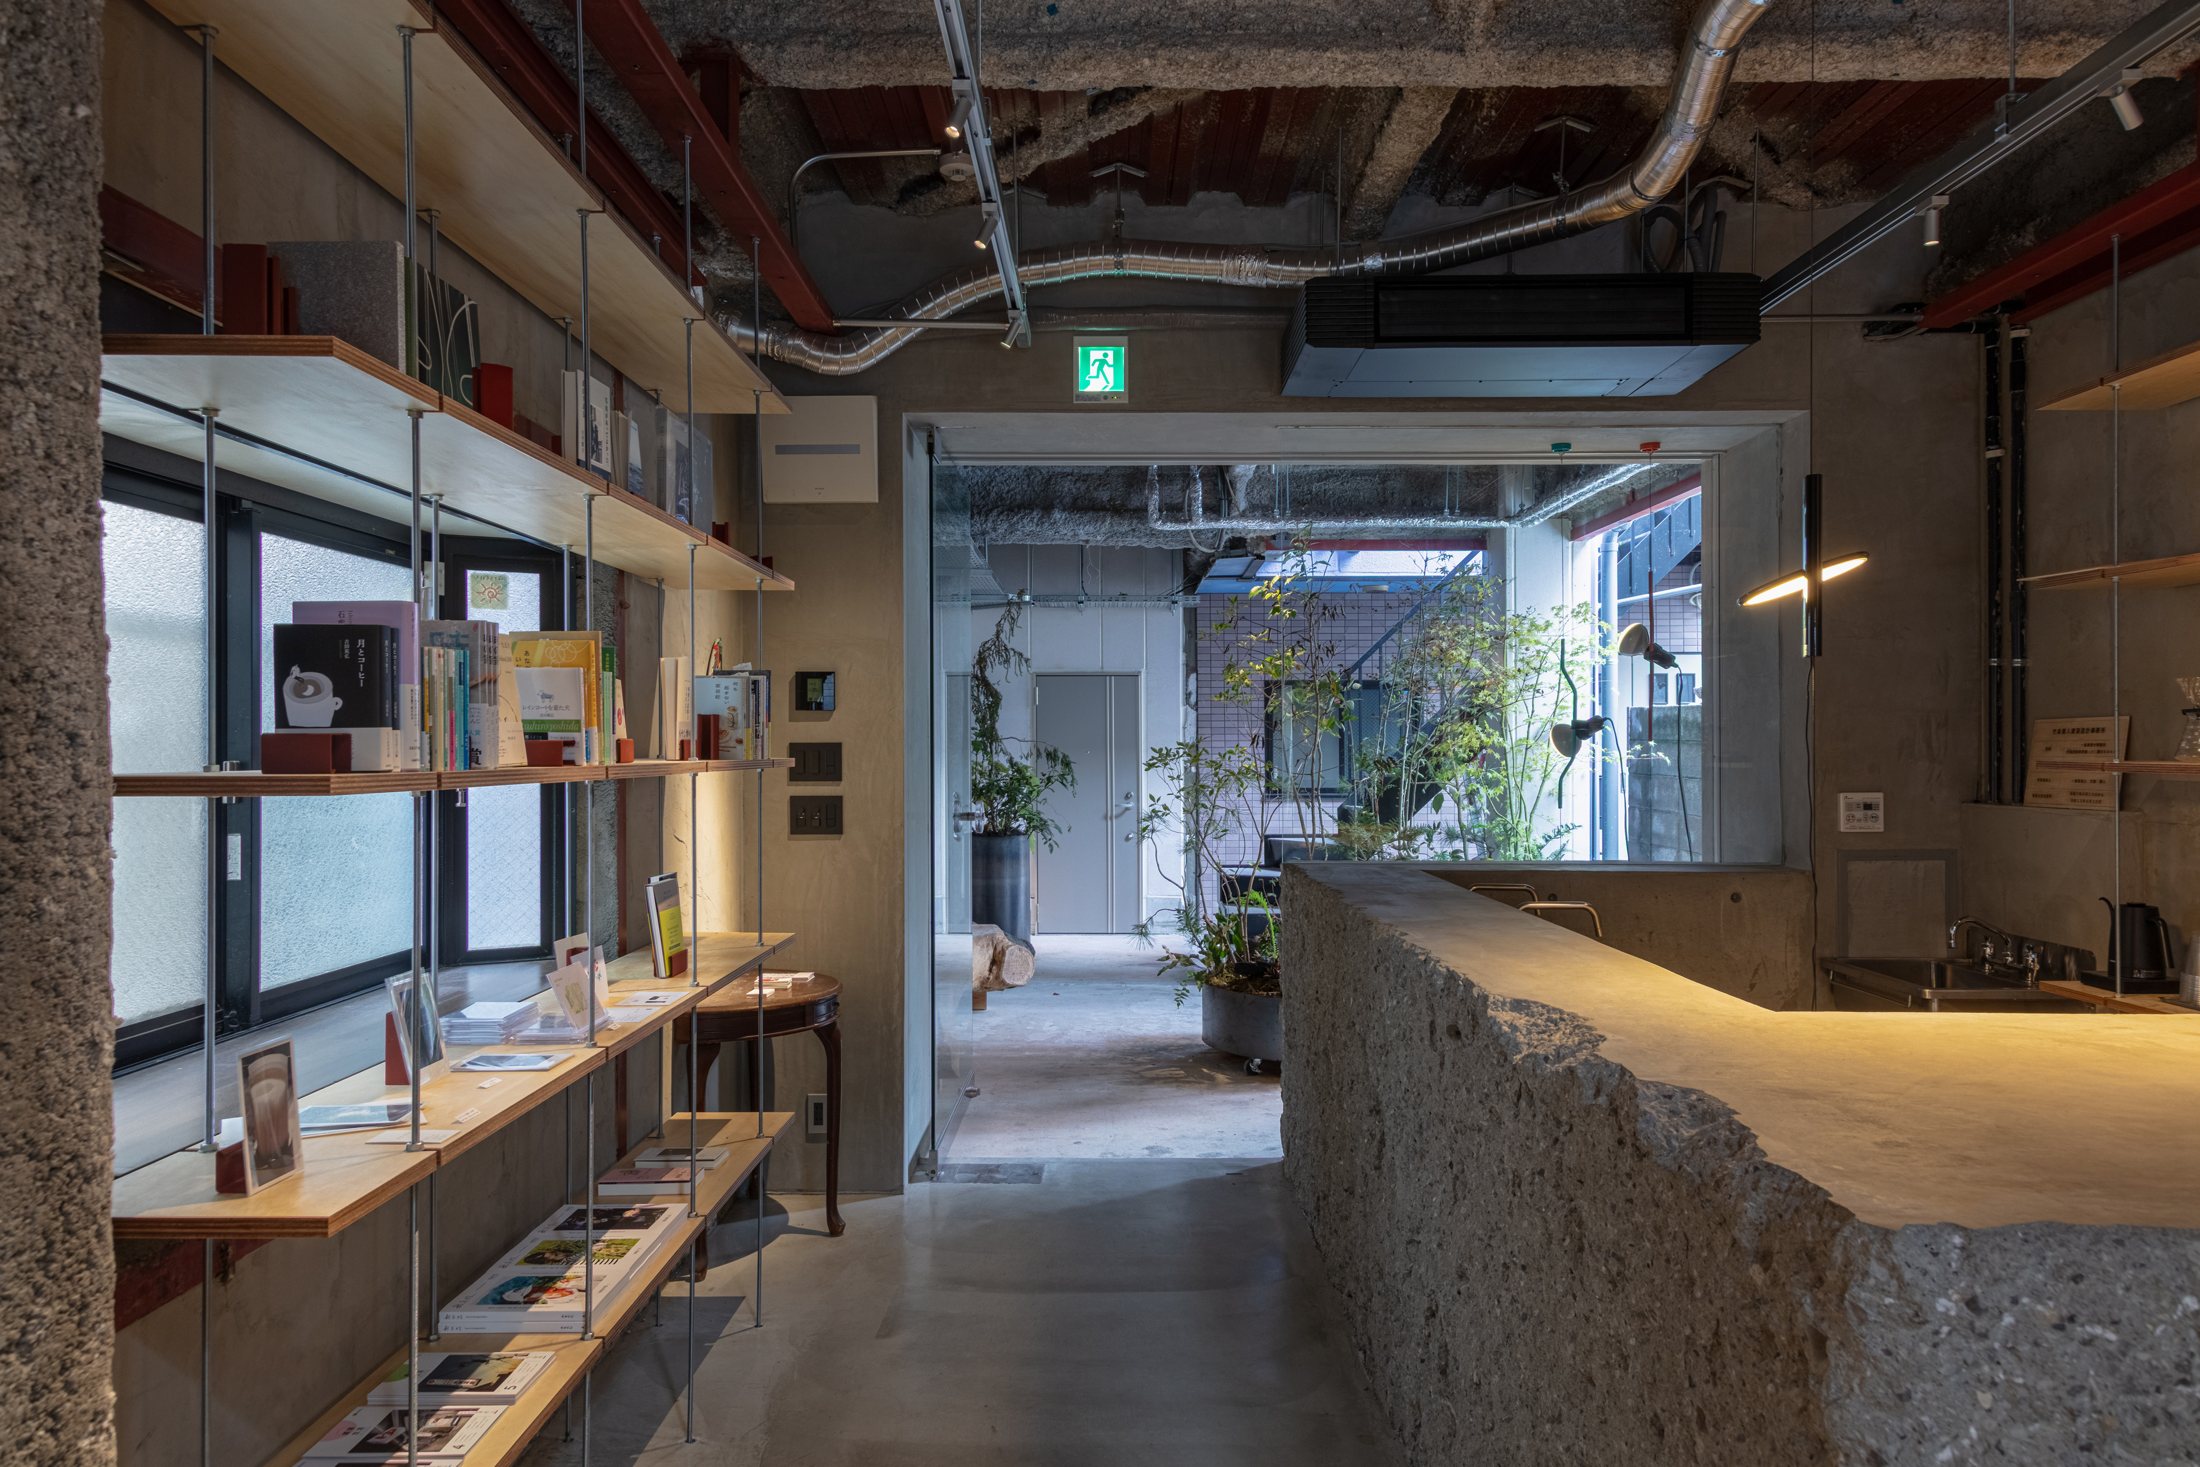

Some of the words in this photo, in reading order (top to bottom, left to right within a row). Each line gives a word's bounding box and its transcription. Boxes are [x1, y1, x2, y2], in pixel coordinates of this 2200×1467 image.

[357, 639, 366, 688] 月とコーヒー
